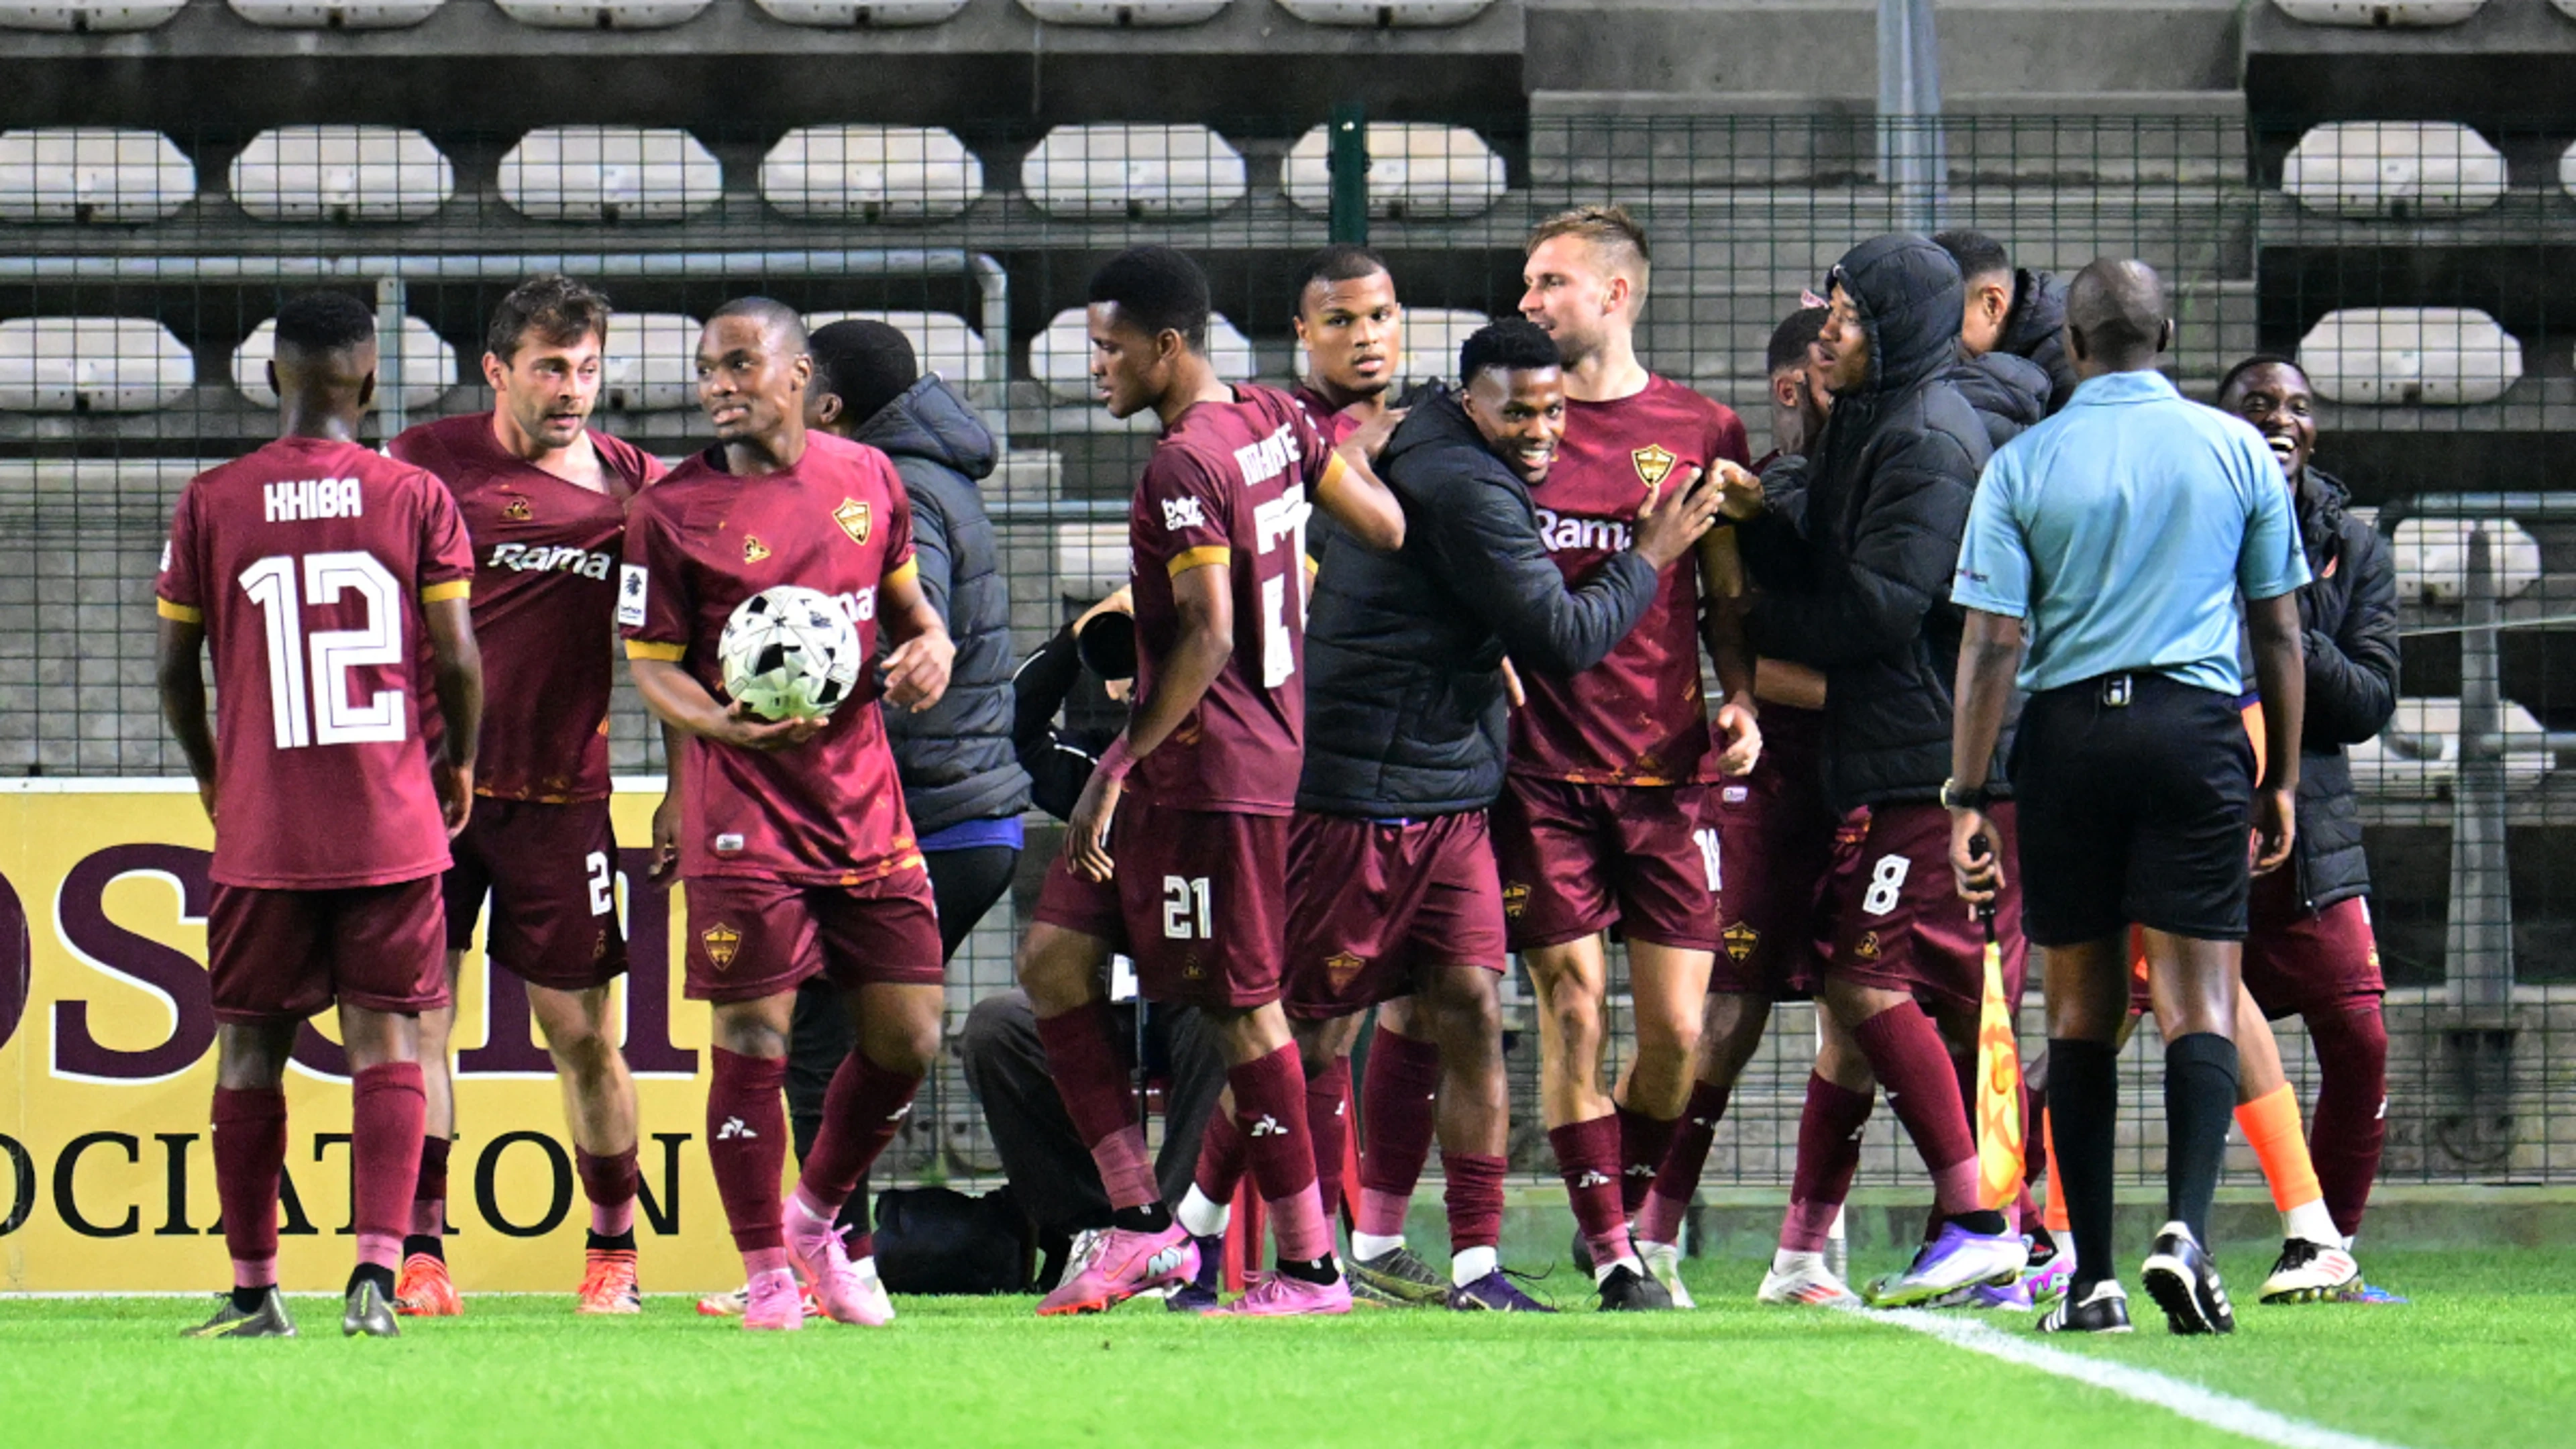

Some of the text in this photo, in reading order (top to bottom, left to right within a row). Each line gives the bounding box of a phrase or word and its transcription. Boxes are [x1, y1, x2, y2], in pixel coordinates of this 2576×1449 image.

[264, 478, 362, 522] KHIBA
[488, 543, 610, 581] Rama
[238, 551, 407, 750] 12
[586, 850, 612, 916] 2
[1693, 828, 1723, 892] 1
[1863, 853, 1911, 916] 8
[1163, 875, 1212, 938] 21
